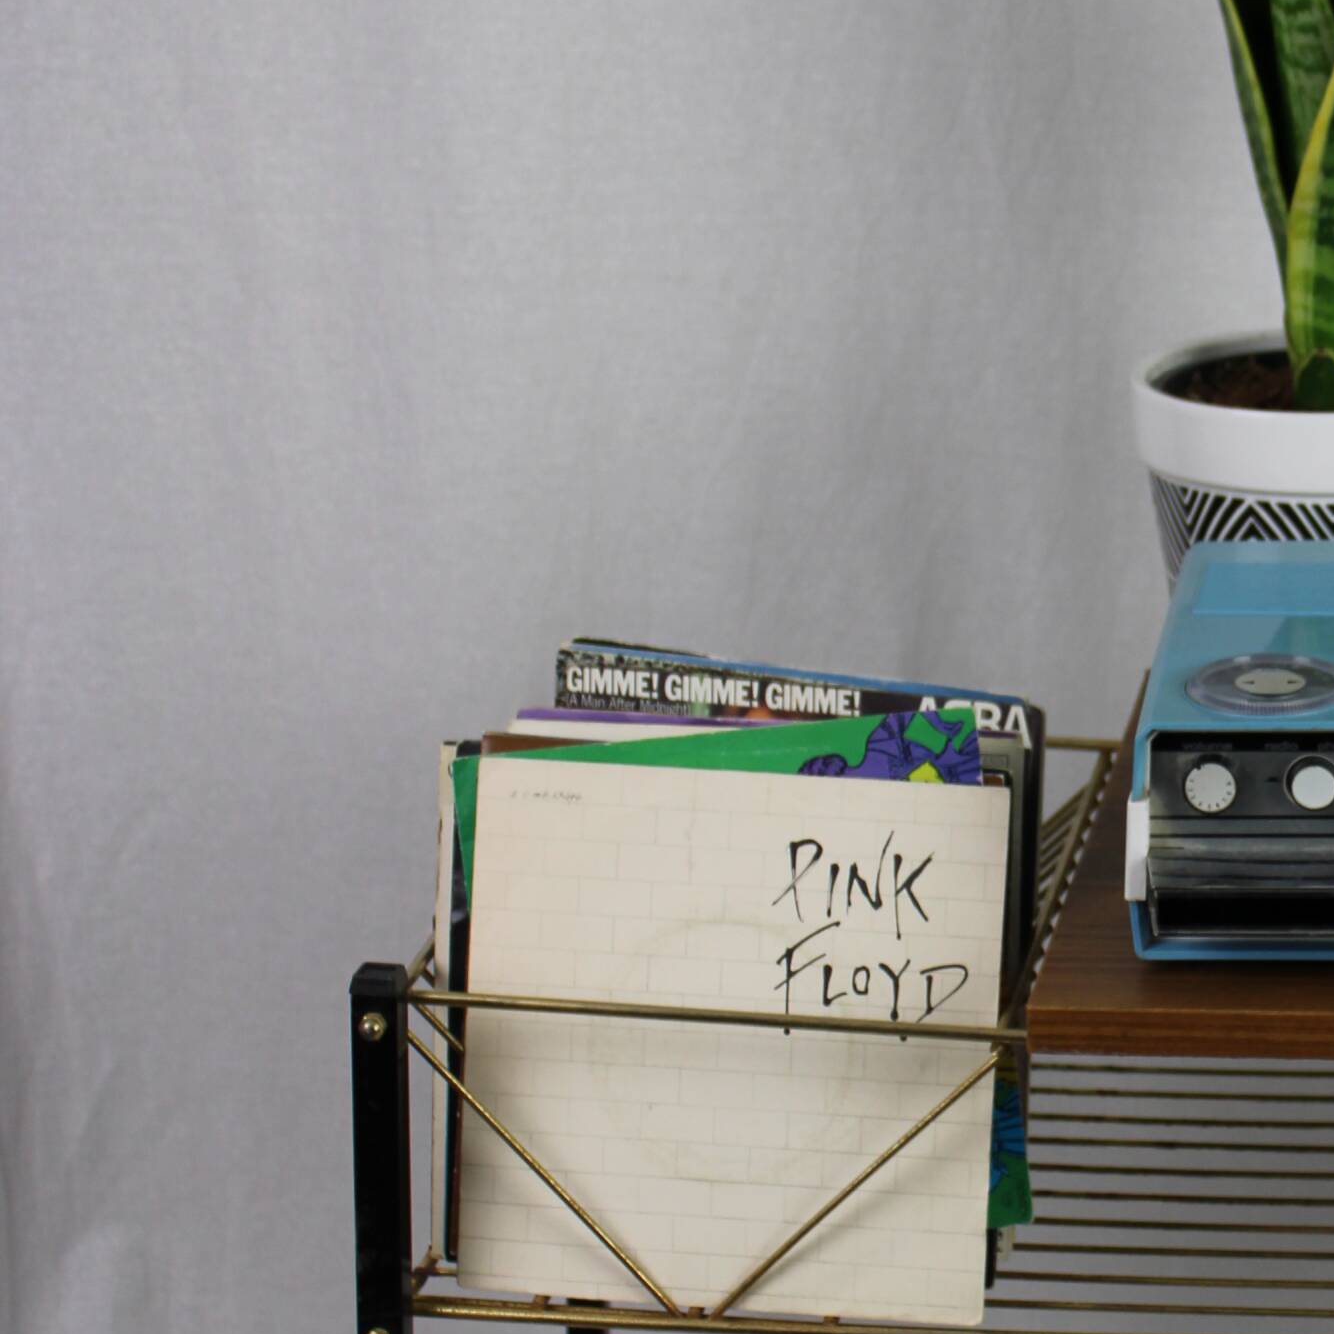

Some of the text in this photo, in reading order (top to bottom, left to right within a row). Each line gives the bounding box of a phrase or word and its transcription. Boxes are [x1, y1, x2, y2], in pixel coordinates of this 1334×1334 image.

[565, 666, 862, 717] GIMME! GIMME! GIMME!
[580, 694, 607, 708] Man
[609, 696, 636, 711] After
[919, 696, 1033, 750] BA
[772, 830, 935, 941] PINK
[774, 921, 968, 1041] FLOYD
